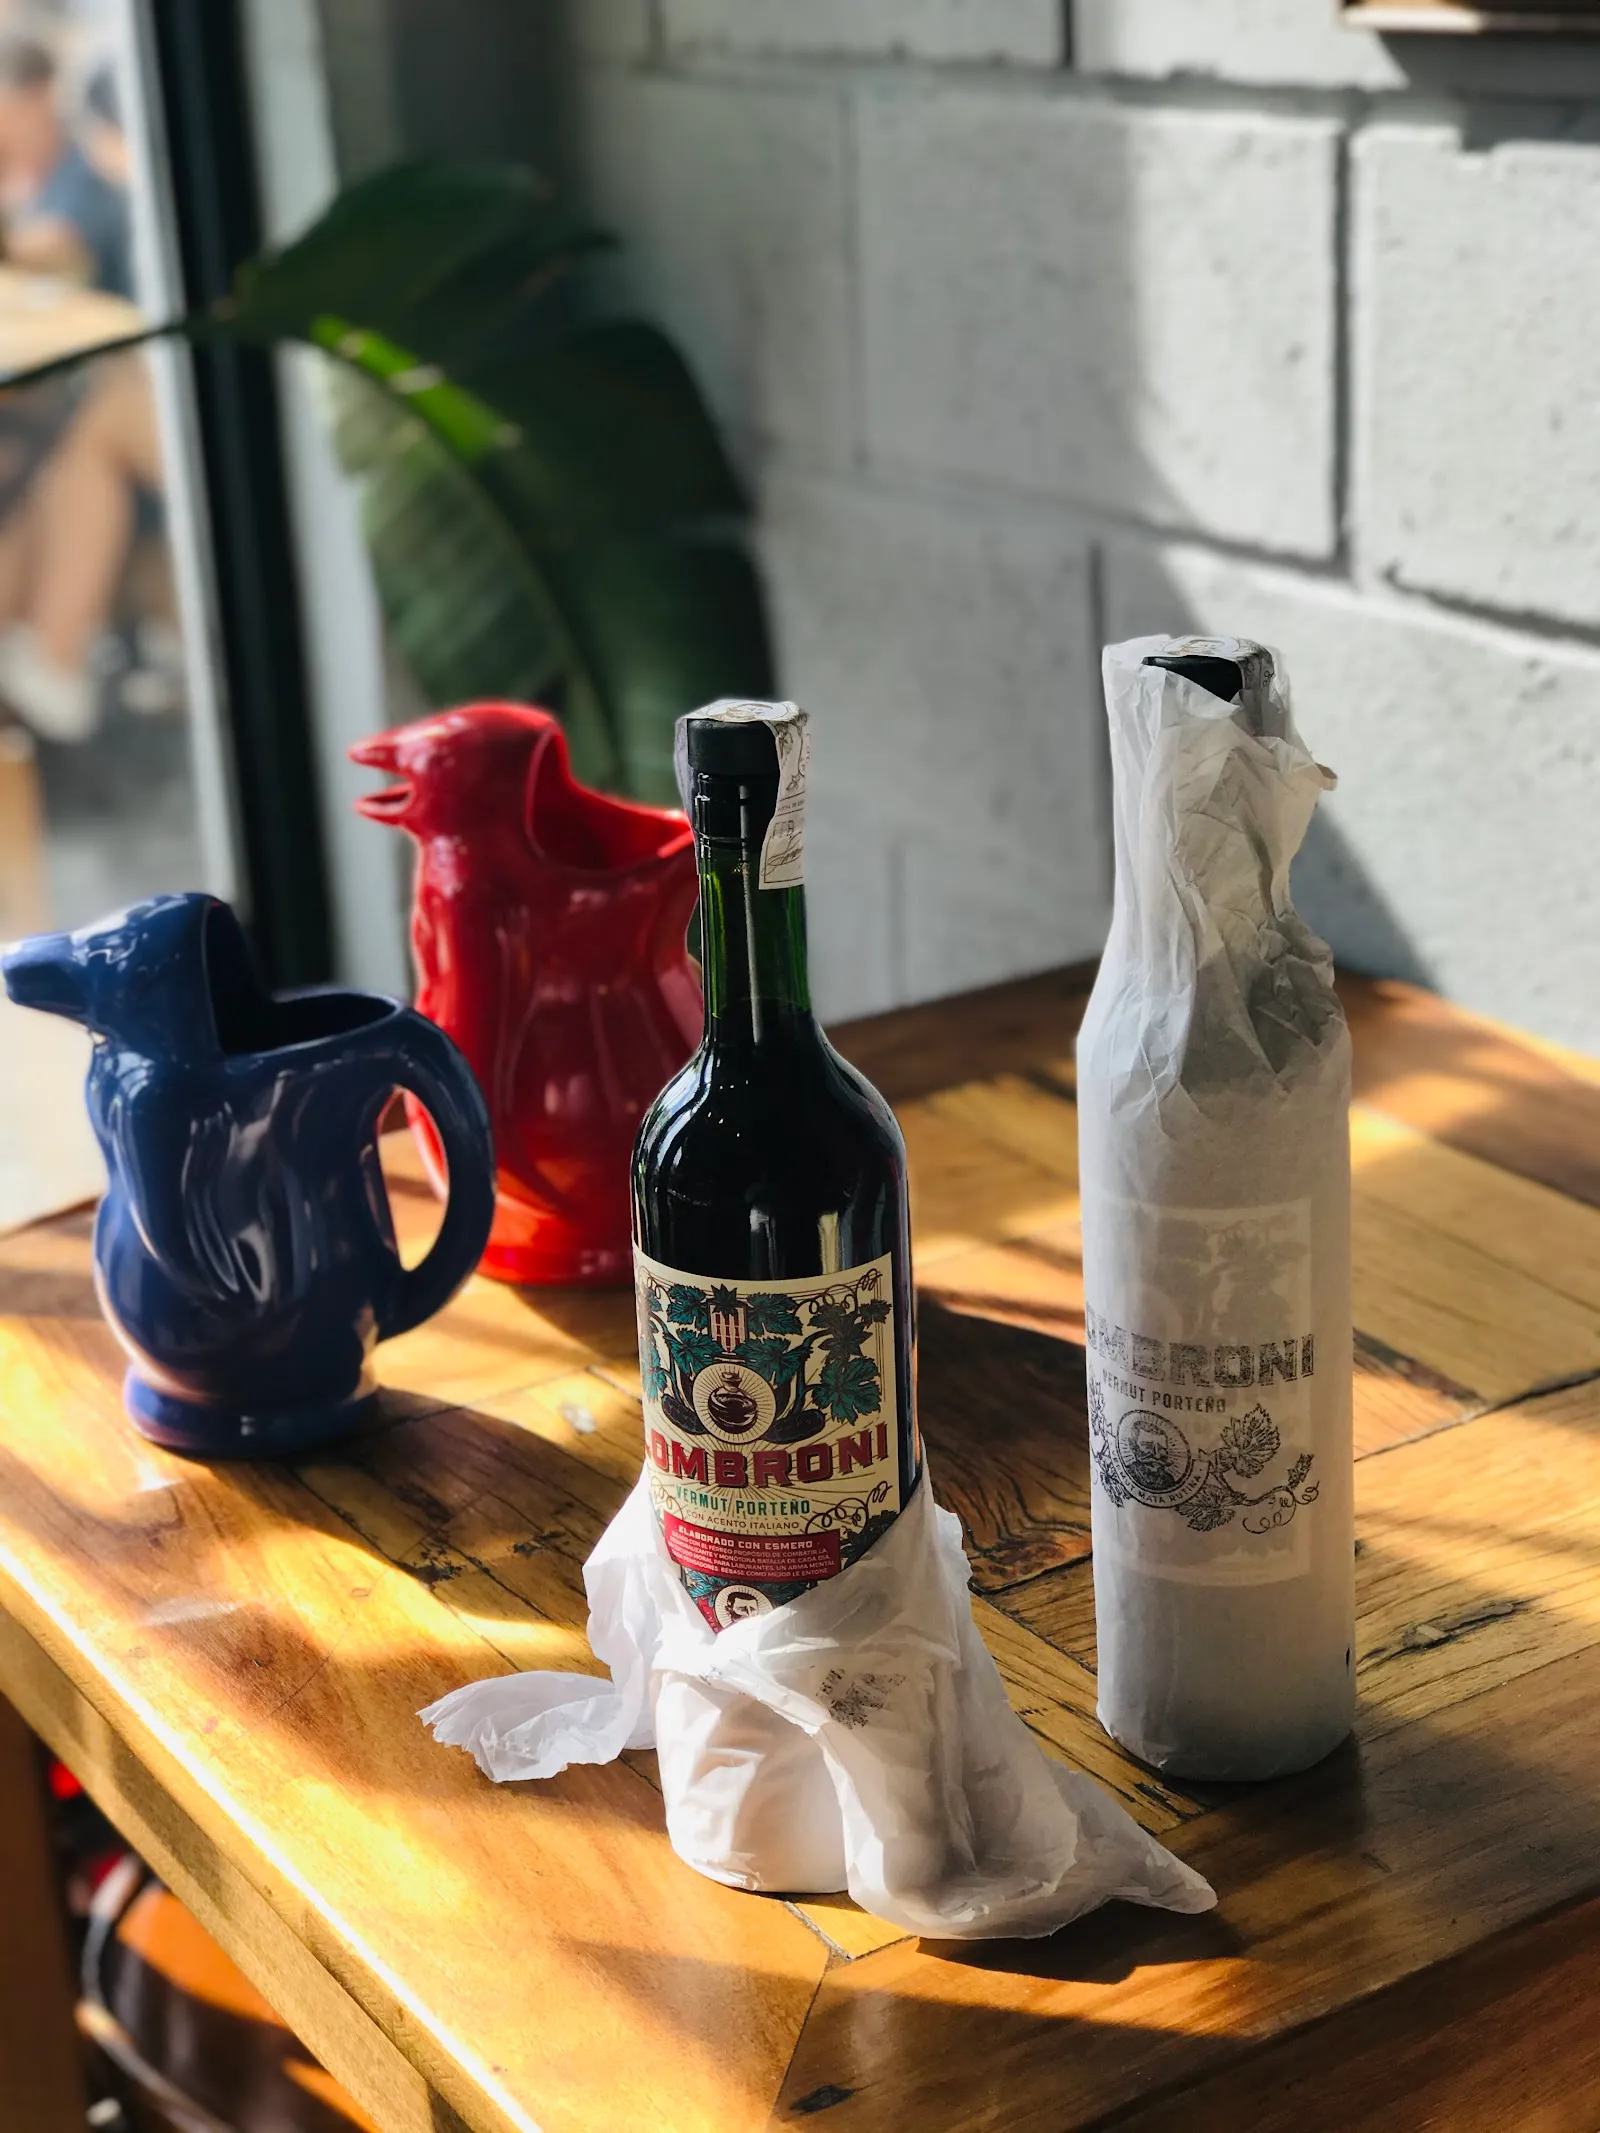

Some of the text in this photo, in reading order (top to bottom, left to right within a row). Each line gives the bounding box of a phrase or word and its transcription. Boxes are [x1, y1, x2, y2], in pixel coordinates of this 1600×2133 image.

[1102, 1369, 1146, 1402] VERMUT
[645, 1421, 889, 1488] OMBRONI
[675, 1484, 810, 1516] VERMUT PORTEÑO
[1138, 1491, 1165, 1503] MATA
[1169, 1475, 1201, 1502] RUTINA
[686, 1509, 800, 1530] CON ACENTO ITALIANO
[678, 1525, 813, 1550] ELABORADO CON ESMERO
[713, 1559, 731, 1568] PARA
[788, 1563, 808, 1571] ARMA
[809, 1560, 835, 1568] MENTAL
[782, 1549, 818, 1558] COMBATIR
